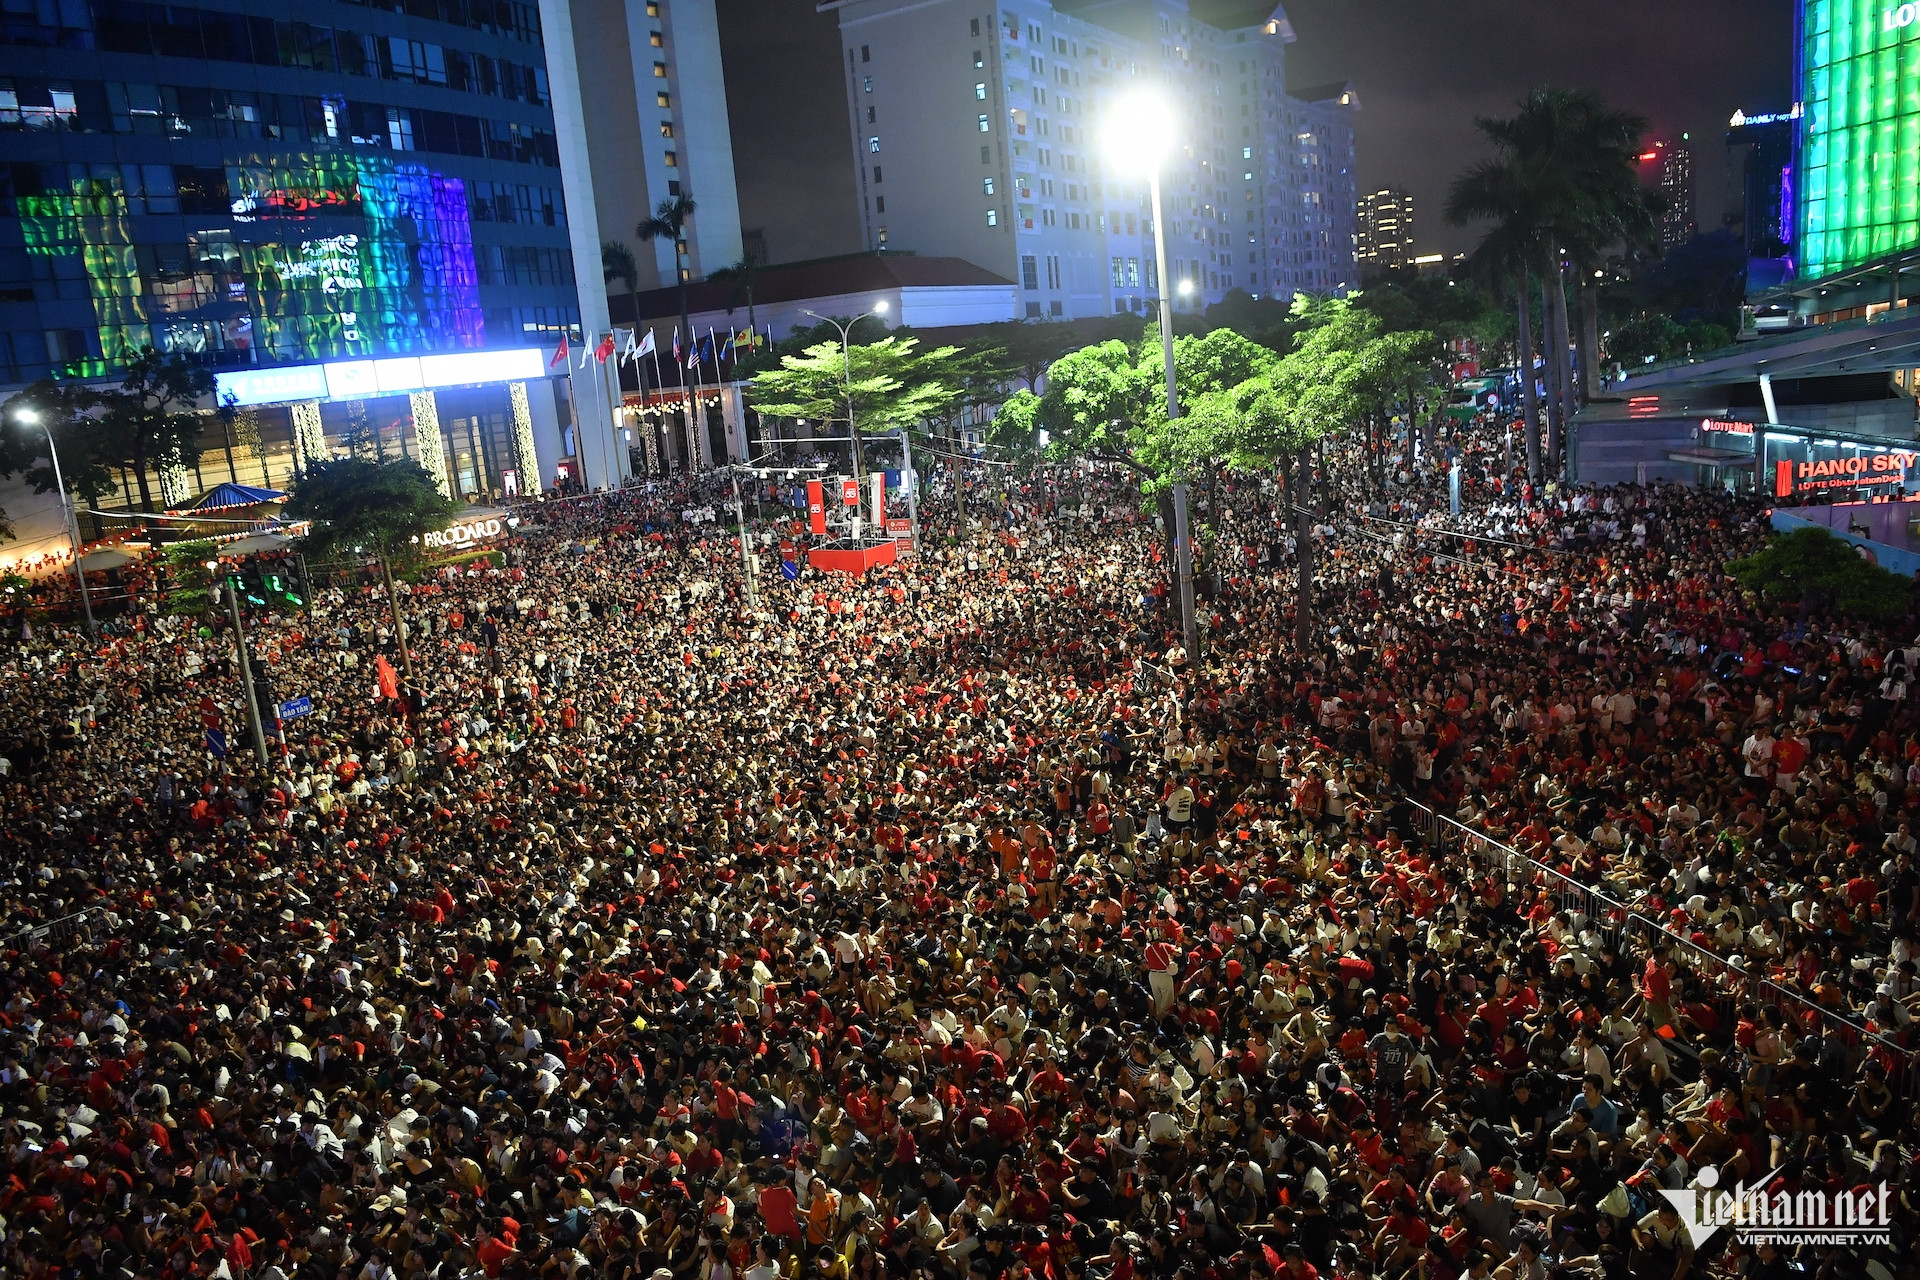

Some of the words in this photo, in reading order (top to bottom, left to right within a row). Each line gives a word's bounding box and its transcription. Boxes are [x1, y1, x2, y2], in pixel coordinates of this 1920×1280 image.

[1798, 456, 1868, 478] HANOI
[1872, 452, 1917, 472] SKY
[1798, 480, 1828, 491] LOTTE
[424, 519, 501, 547] BRODARD
